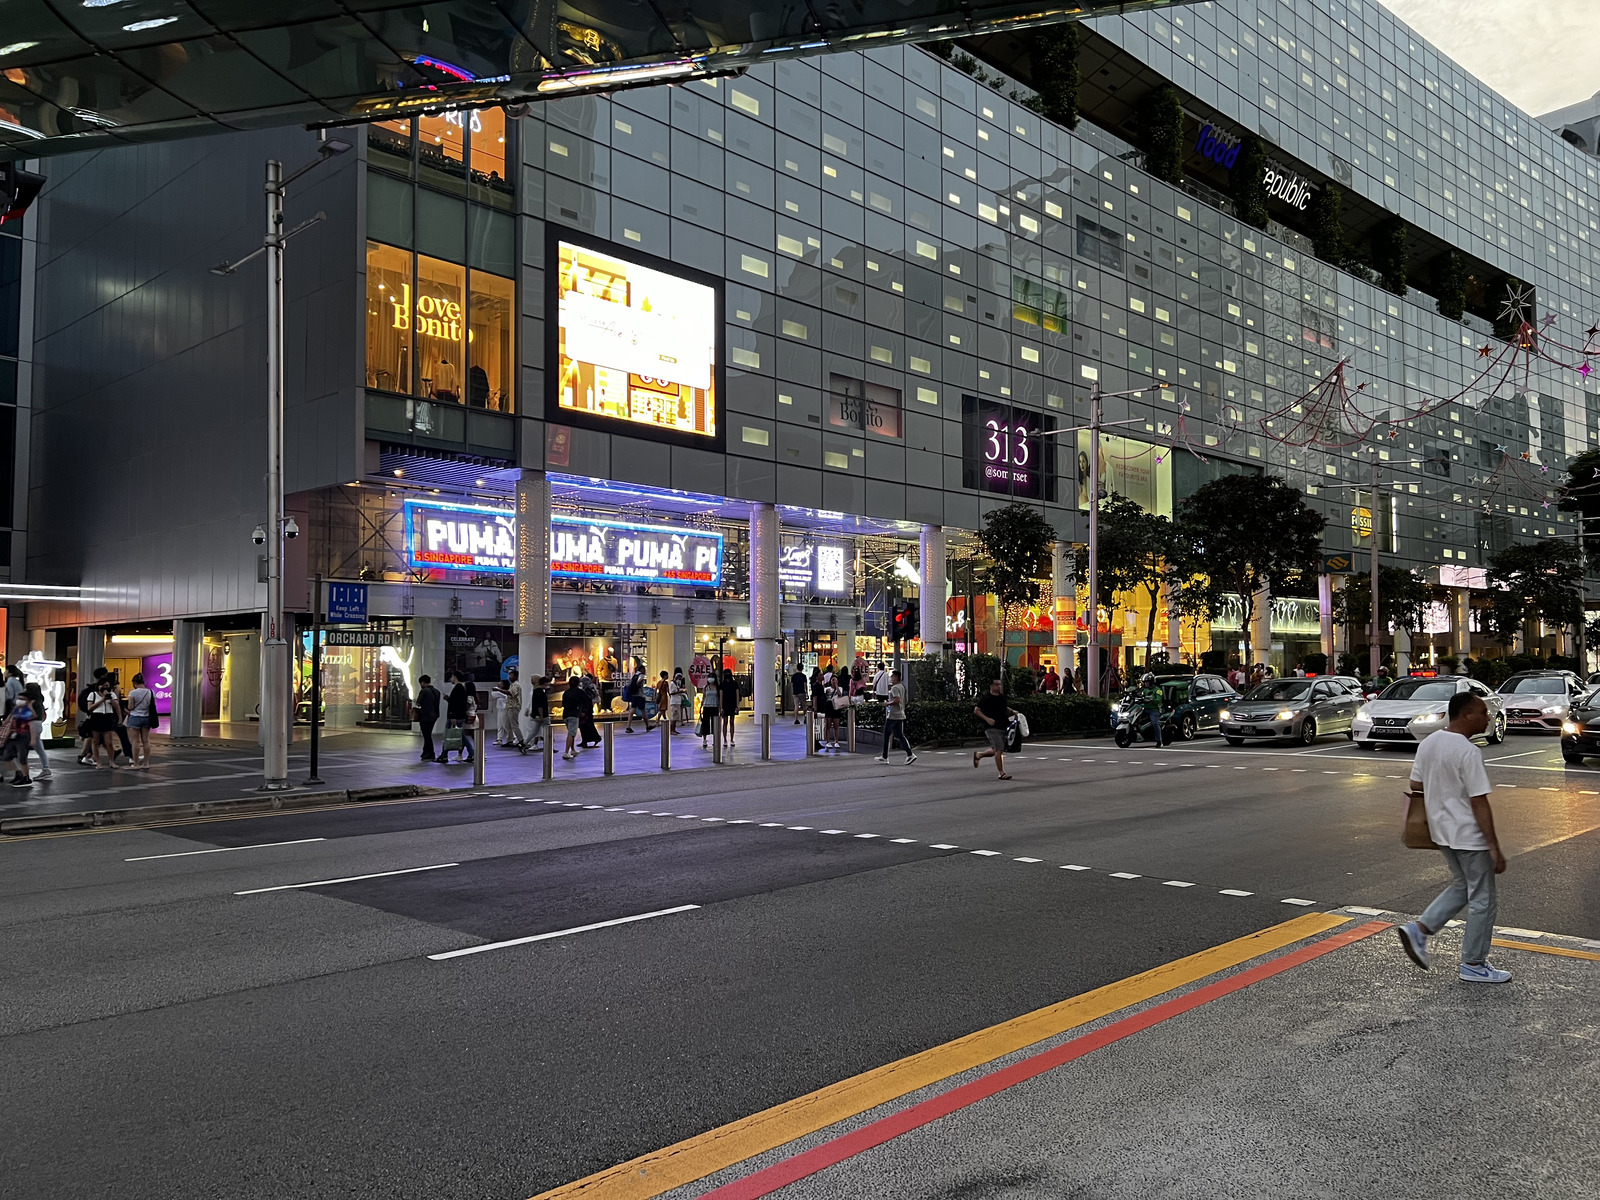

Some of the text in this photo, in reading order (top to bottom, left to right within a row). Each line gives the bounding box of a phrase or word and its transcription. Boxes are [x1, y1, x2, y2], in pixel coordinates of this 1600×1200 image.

[1263, 166, 1311, 211] epublic
[392, 302, 474, 344] Bonito
[985, 419, 1029, 466] 313
[985, 465, 1028, 483] @somrset
[427, 519, 514, 557] PUMA
[551, 531, 604, 563] UMA
[618, 538, 684, 569] PUMA
[424, 552, 473, 564] SINGAPORE
[475, 556, 499, 567] PUMA
[562, 563, 603, 573] SINGAPORE
[604, 565, 624, 575] PUMA
[676, 571, 711, 581] SINGAPORE
[335, 605, 348, 613] Keep
[329, 632, 391, 644] ORCHARD RD
[689, 664, 711, 674] SALE
